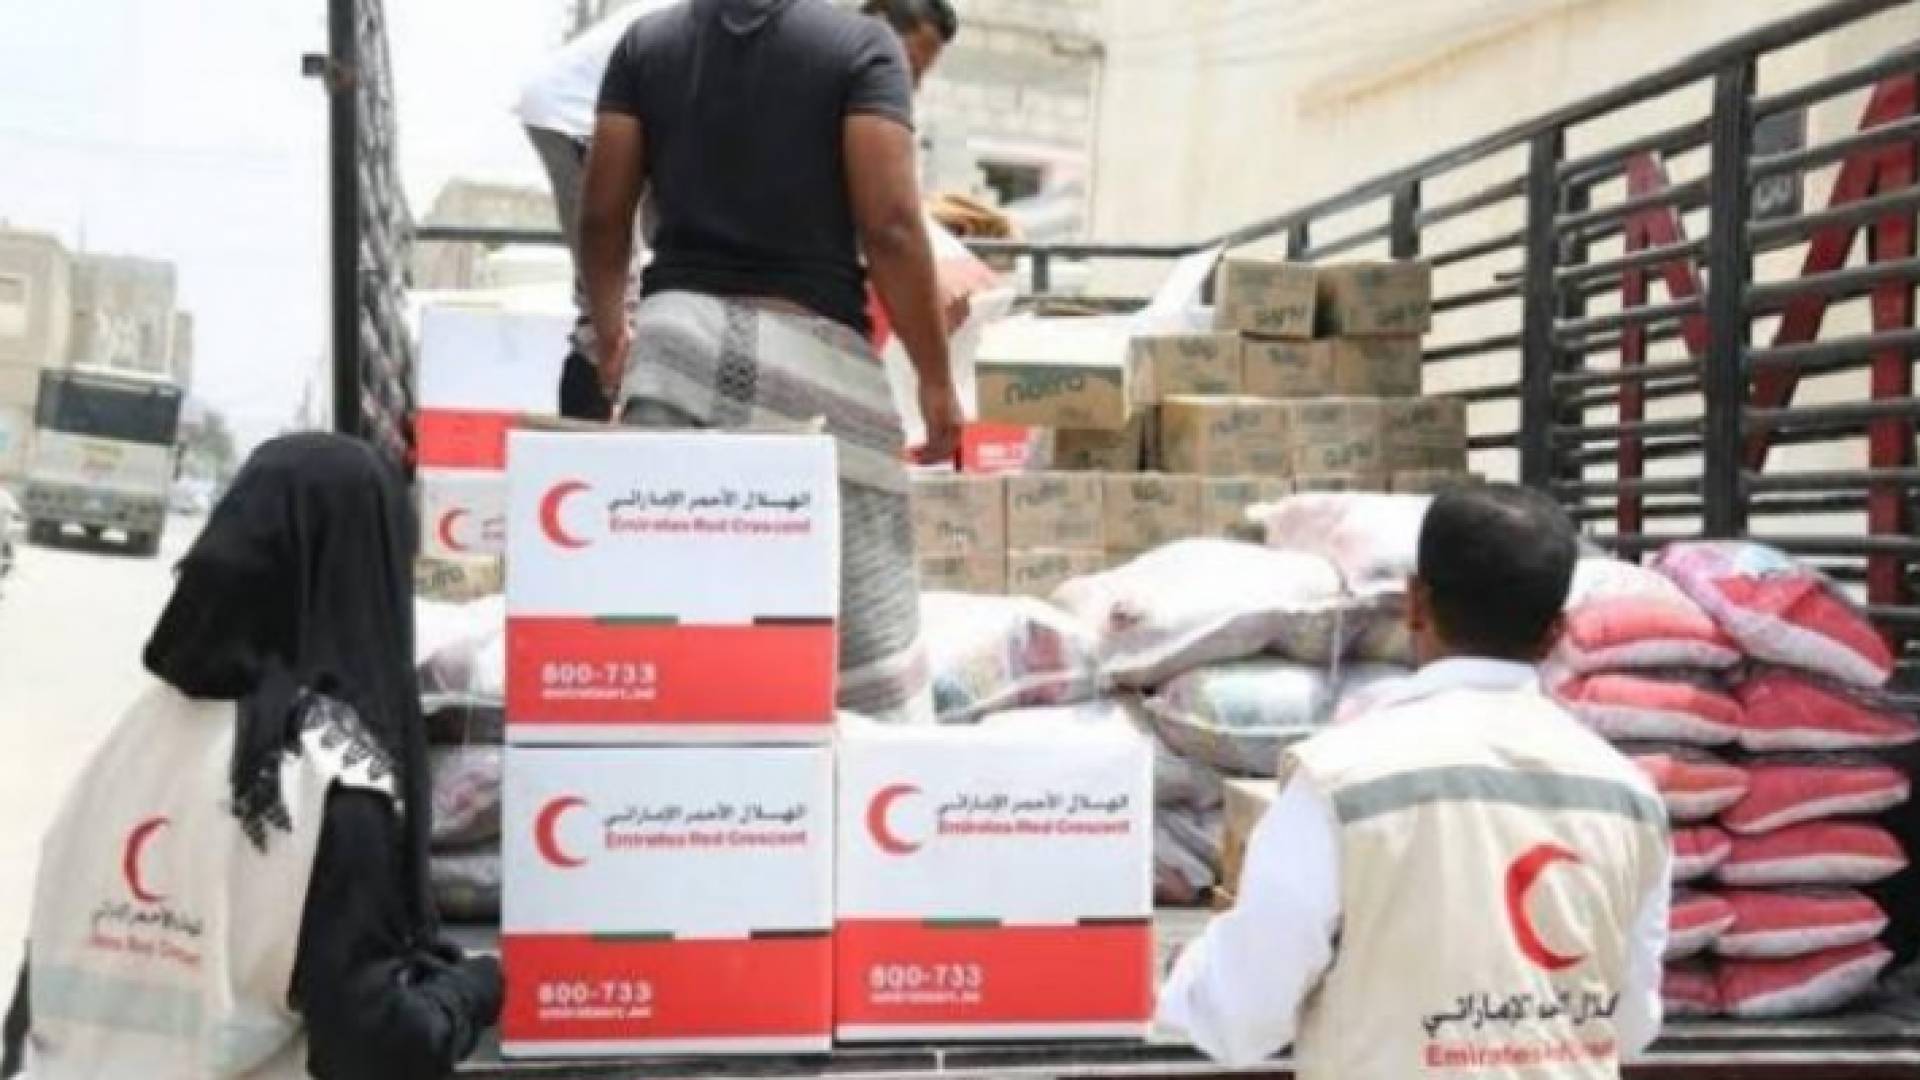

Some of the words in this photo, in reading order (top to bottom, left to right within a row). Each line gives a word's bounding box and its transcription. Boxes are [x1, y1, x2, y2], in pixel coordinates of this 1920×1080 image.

[609, 517, 690, 533] Emirates
[693, 517, 728, 532] Red
[731, 518, 811, 533] Crescent
[542, 662, 657, 685] 800-733
[938, 819, 1013, 835] Emirates
[1015, 819, 1052, 834] Red
[1055, 818, 1130, 834] Crescent
[605, 831, 686, 848] Emirates
[688, 830, 723, 847] Red
[728, 830, 807, 846] Crescent
[870, 963, 983, 988] 800-733
[537, 981, 653, 1004] 800-733
